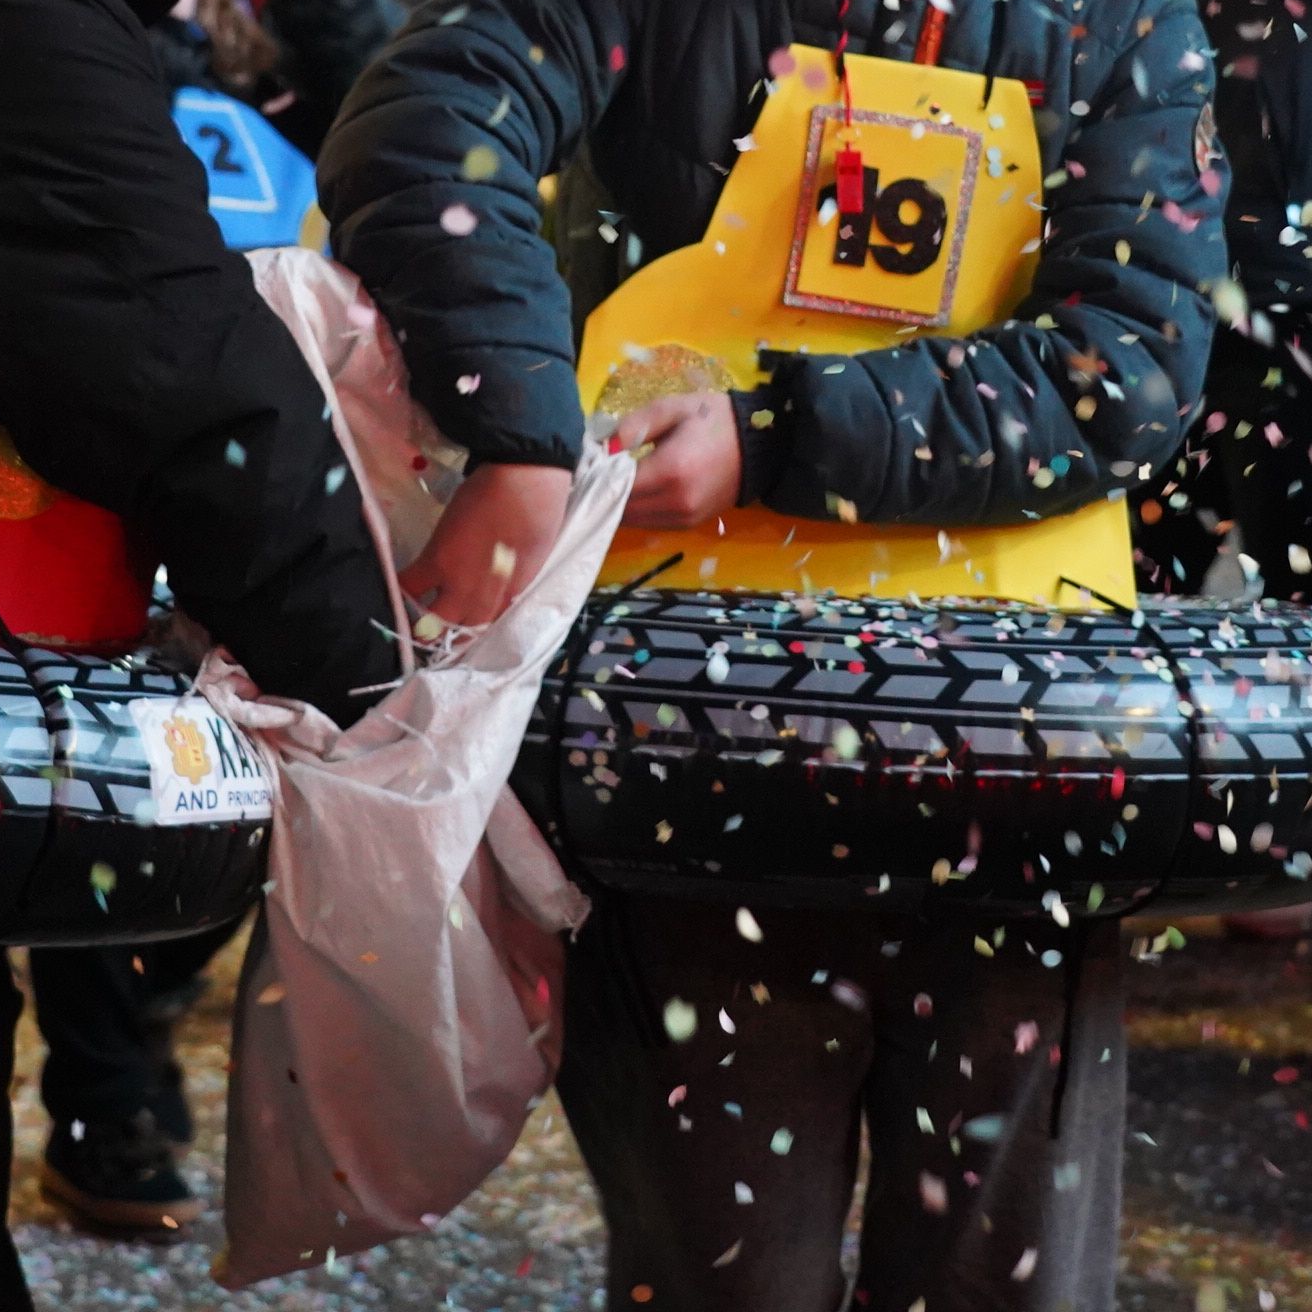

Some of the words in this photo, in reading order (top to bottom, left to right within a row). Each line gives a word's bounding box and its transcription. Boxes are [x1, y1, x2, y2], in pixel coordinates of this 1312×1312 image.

[197, 124, 245, 173] 2
[817, 164, 948, 276] 19
[175, 789, 218, 811] AND
